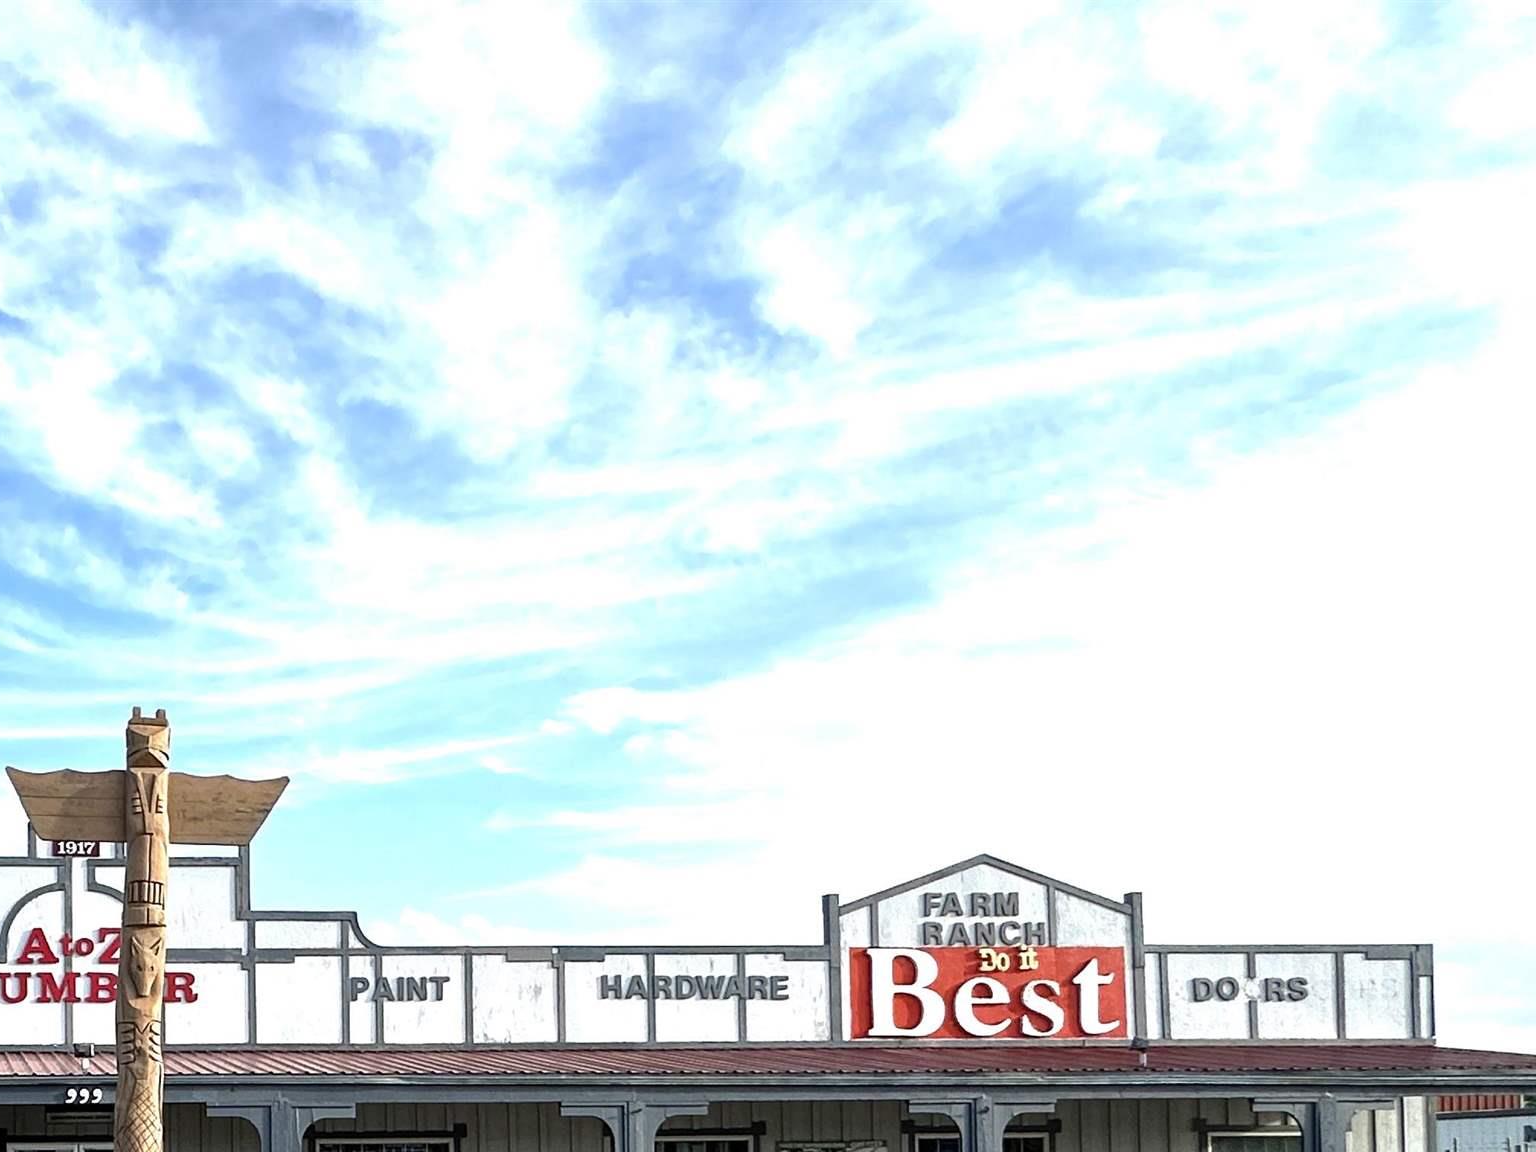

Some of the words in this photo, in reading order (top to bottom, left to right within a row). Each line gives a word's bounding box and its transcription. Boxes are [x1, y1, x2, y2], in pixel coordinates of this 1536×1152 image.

[56, 841, 96, 856] 1917
[921, 892, 1019, 917] FARM
[921, 921, 1045, 946] RANCH
[978, 948, 1010, 972] Do
[1018, 944, 1040, 970] it
[348, 976, 450, 1002] PAINT
[600, 974, 789, 1000] HARDWARE
[866, 948, 1120, 1038] Best
[64, 1088, 103, 1104] 999
